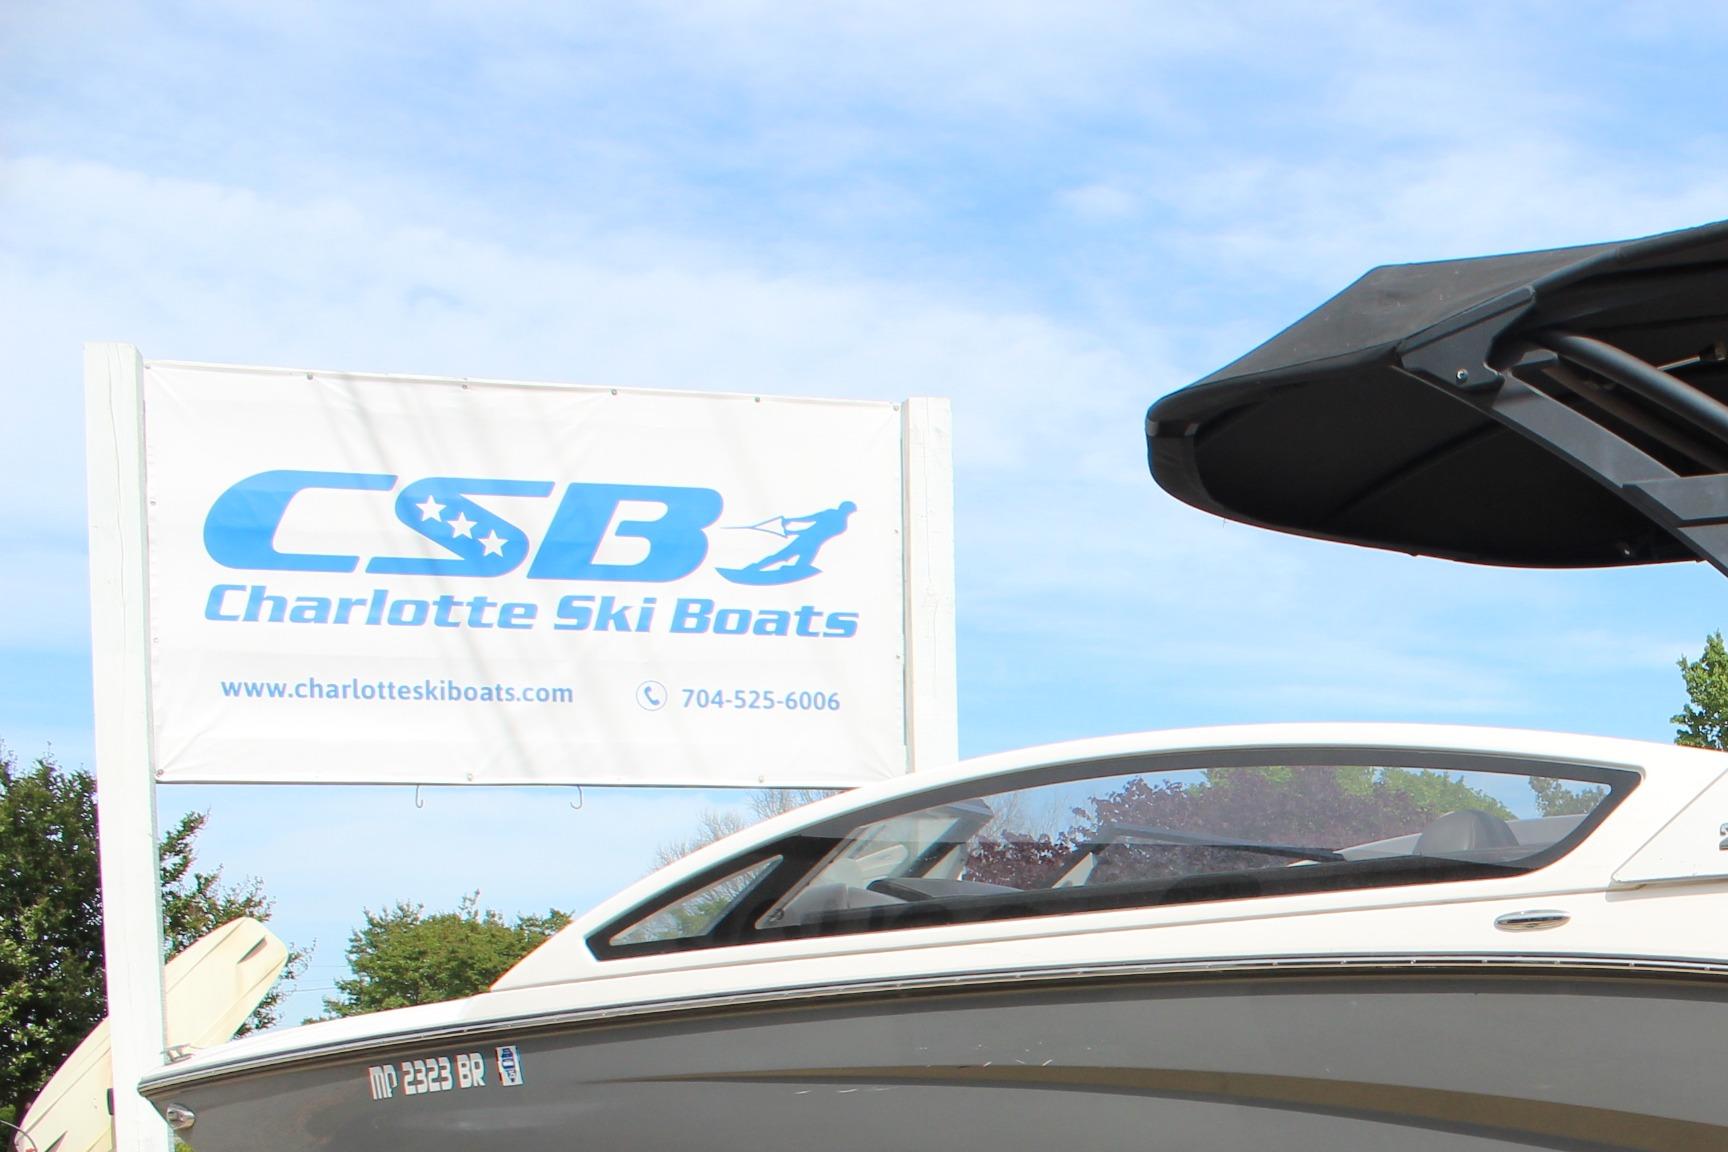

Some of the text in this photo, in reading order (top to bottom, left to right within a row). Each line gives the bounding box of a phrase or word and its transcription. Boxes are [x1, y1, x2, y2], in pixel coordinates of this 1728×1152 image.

[203, 470, 725, 583] CSB
[203, 584, 860, 639] Charlotte Ski Boats
[220, 677, 574, 704] www.charlotteskiboats.com
[681, 687, 841, 712] 704-525-6006
[401, 1056, 454, 1096] 2323
[456, 1053, 487, 1089] BR
